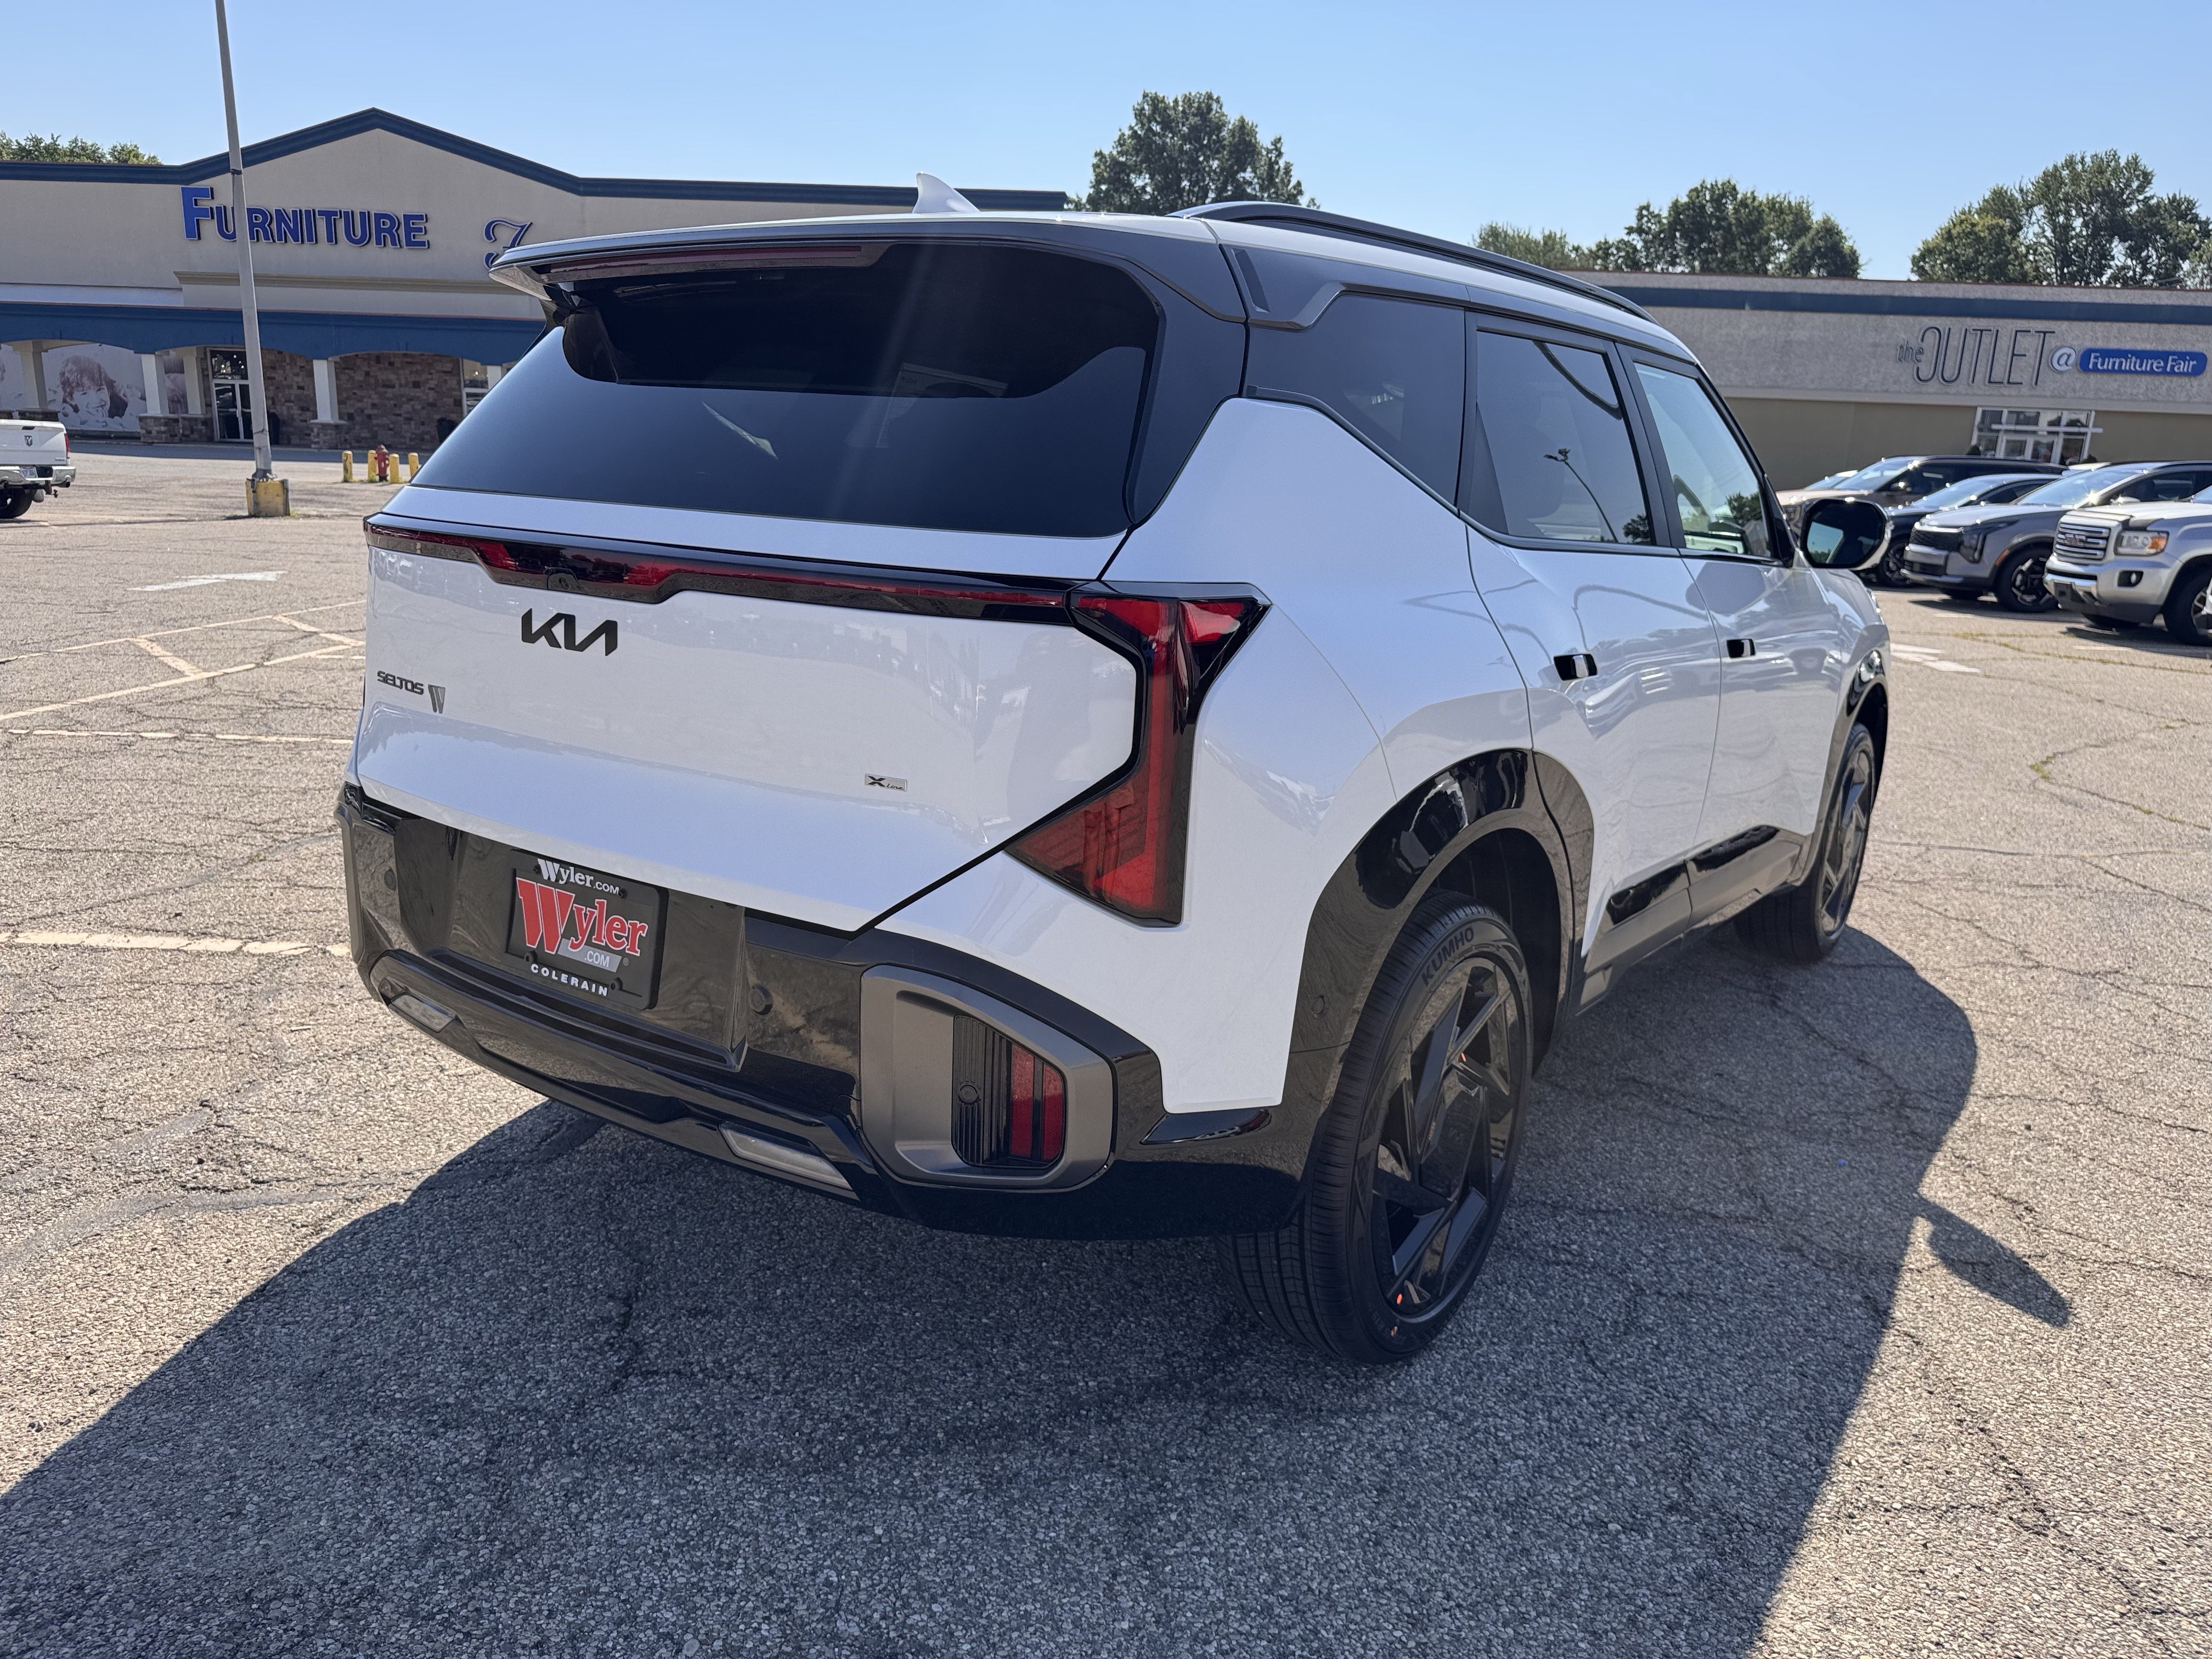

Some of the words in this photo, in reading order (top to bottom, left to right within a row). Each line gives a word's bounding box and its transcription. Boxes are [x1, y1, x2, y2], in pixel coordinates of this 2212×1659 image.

[1898, 338, 1924, 363] the
[1914, 326, 2056, 386] OUTLET
[2089, 352, 2164, 373] Furniture
[2166, 355, 2197, 373] Fair
[522, 608, 618, 656] KIA
[377, 670, 424, 695] SELTOS
[516, 877, 648, 956] Wyler
[531, 963, 608, 996] COLERAIN
[1421, 927, 1474, 986] KUMHO
